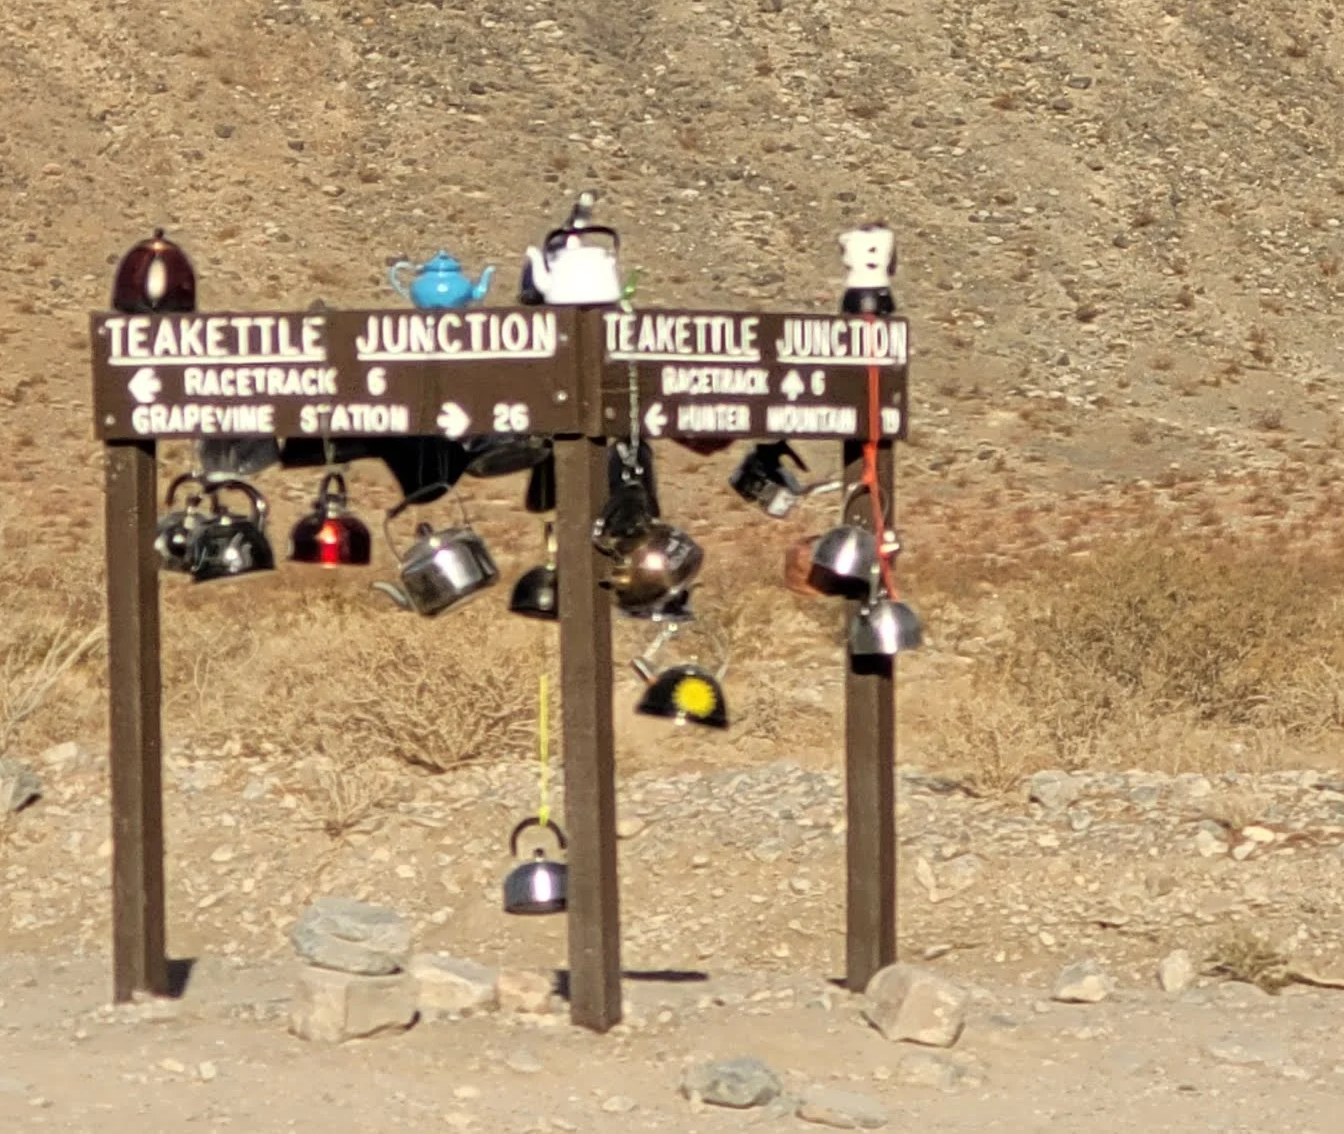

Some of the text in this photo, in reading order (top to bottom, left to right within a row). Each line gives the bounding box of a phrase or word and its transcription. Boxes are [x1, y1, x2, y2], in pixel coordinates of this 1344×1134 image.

[105, 313, 556, 356] TEAKETTLE JUNCTION
[604, 314, 907, 364] TEAKETTLE JUNCTION
[184, 368, 387, 396] RACETRACK 6
[661, 366, 826, 396] RACETRACK 6
[132, 404, 275, 434] GRAPEVINE
[493, 403, 530, 432] 26
